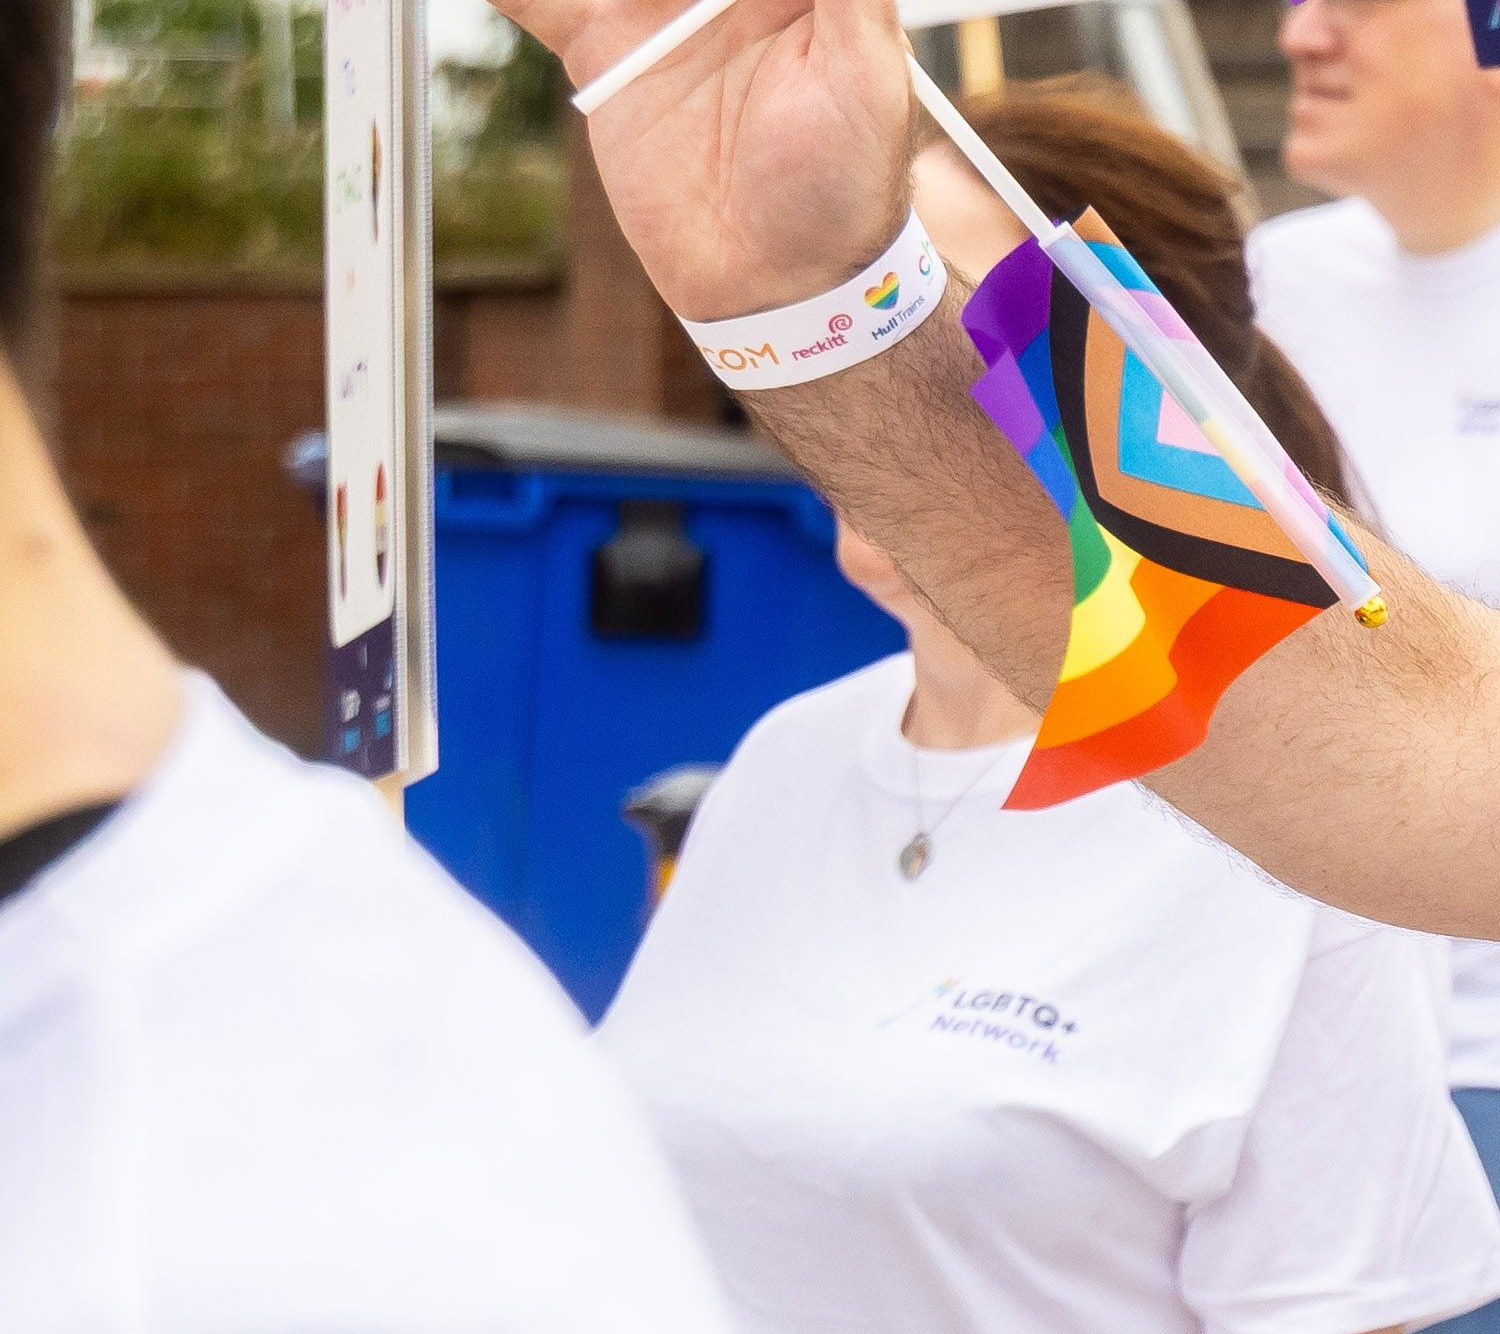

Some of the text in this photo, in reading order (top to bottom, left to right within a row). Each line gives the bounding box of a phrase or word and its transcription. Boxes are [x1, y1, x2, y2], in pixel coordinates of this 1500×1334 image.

[791, 333, 849, 361] reckitt
[953, 988, 1078, 1035] LGBTQ+
[930, 1014, 1061, 1064] Network
